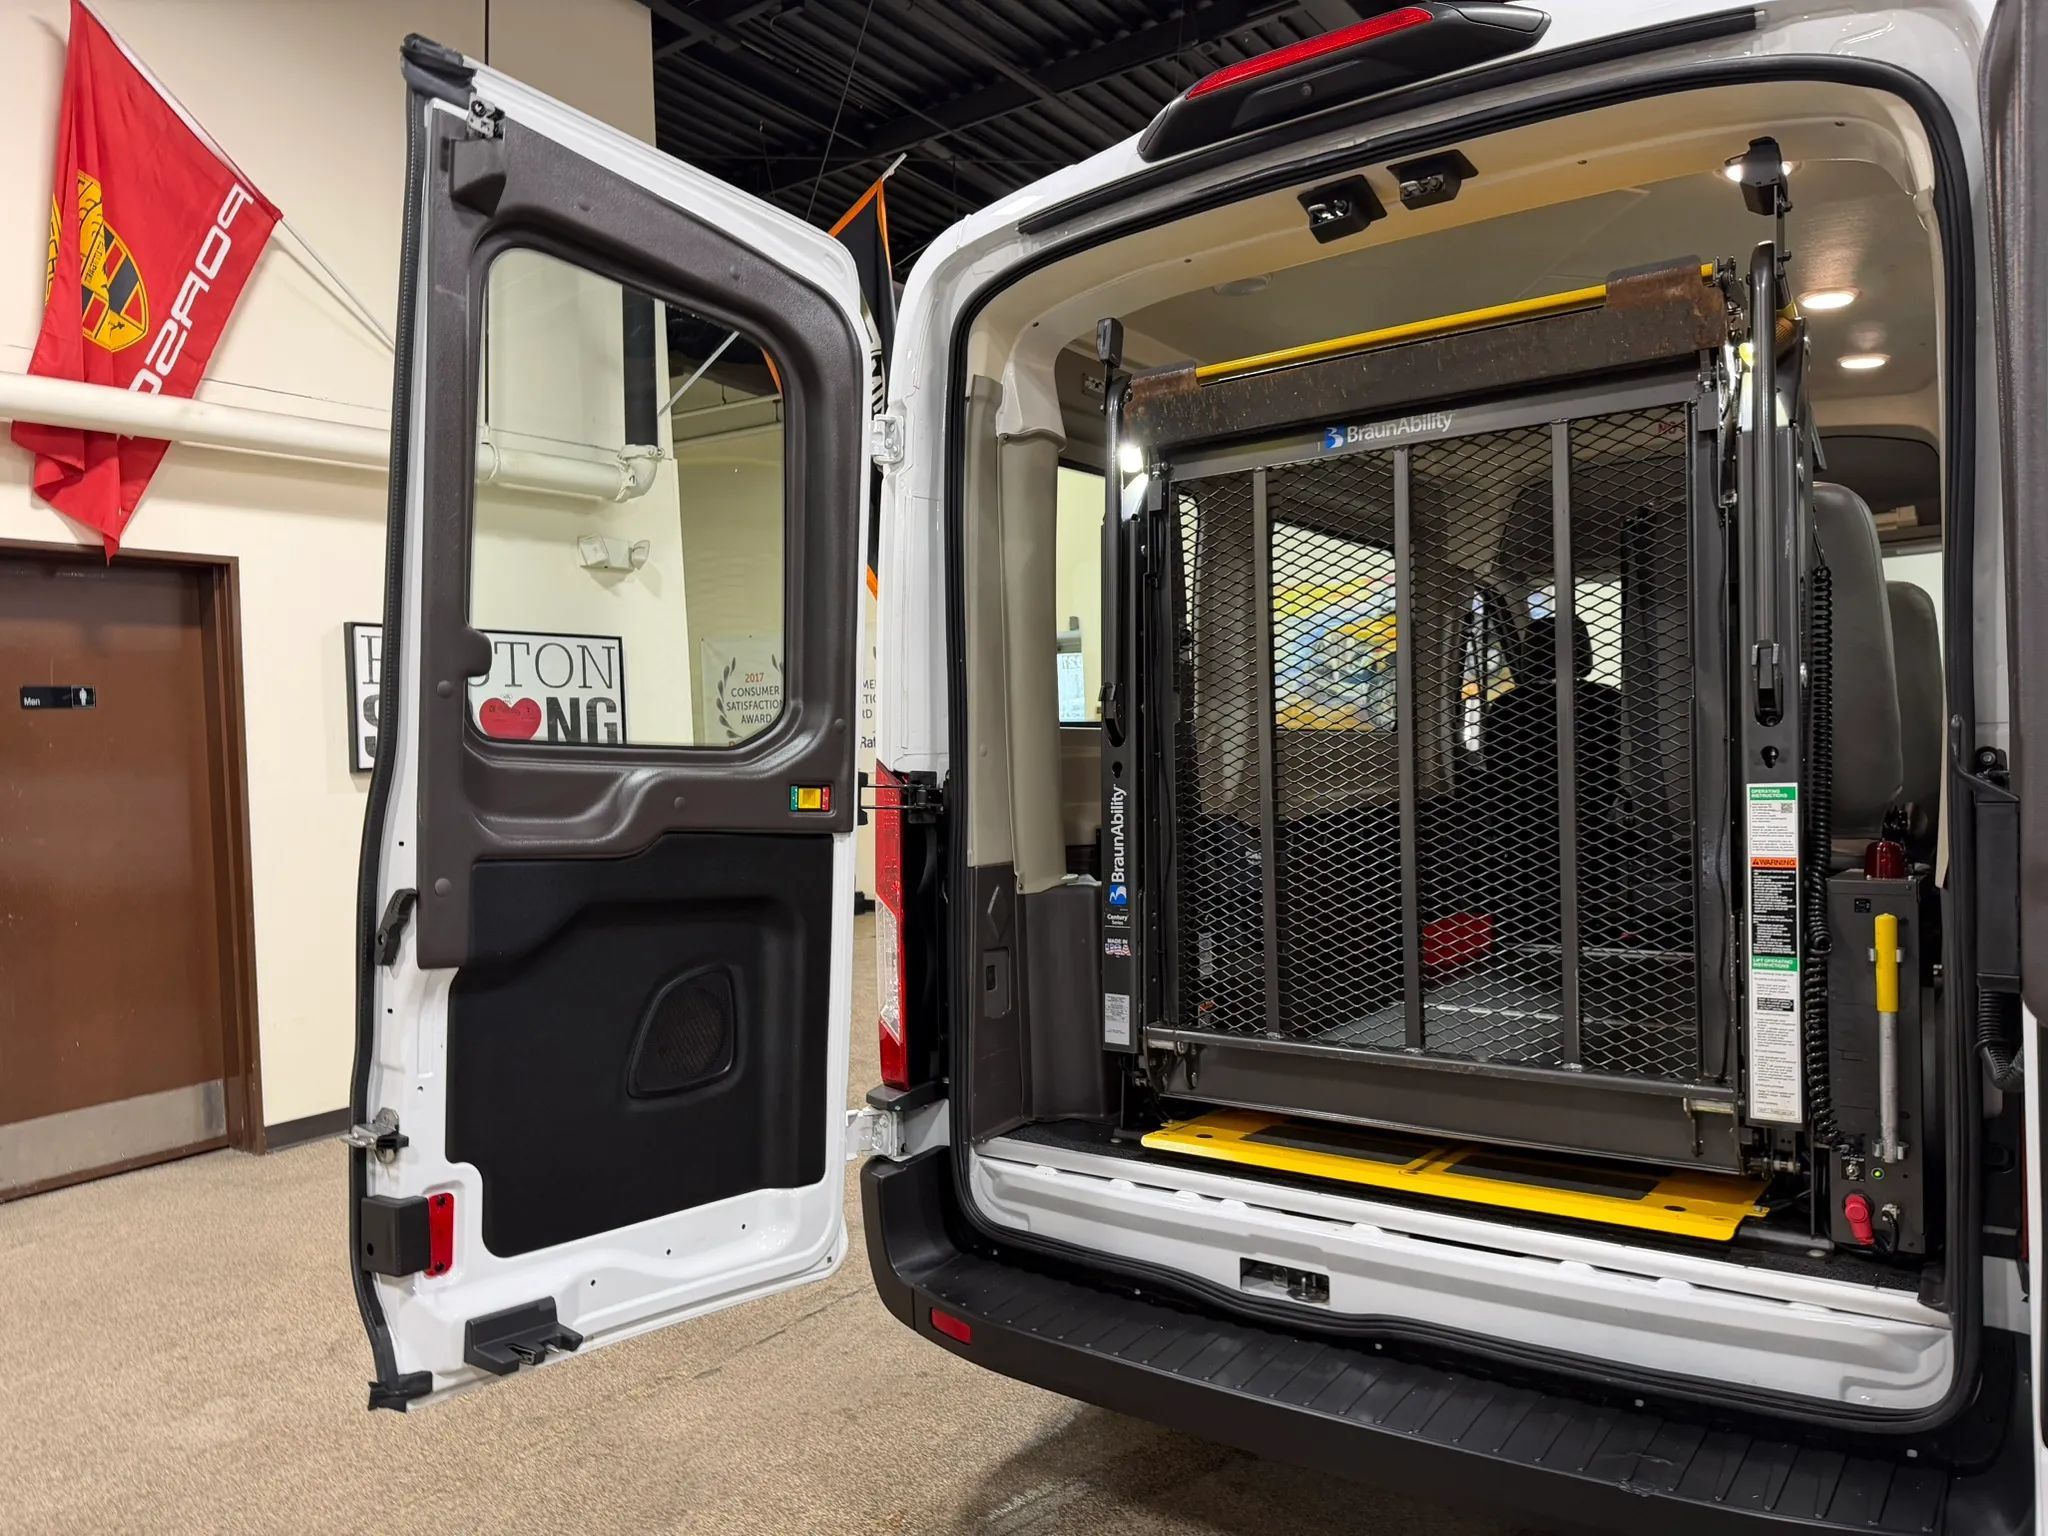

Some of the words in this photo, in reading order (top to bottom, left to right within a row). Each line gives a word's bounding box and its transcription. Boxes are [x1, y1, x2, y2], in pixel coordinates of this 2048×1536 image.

[1347, 412, 1453, 443] BraunAbility
[745, 672, 764, 683] 2017
[730, 685, 780, 697] CONSUMER
[741, 713, 772, 724] AWARD
[1110, 785, 1127, 882] BraunAbility
[1759, 858, 1796, 866] WARNING
